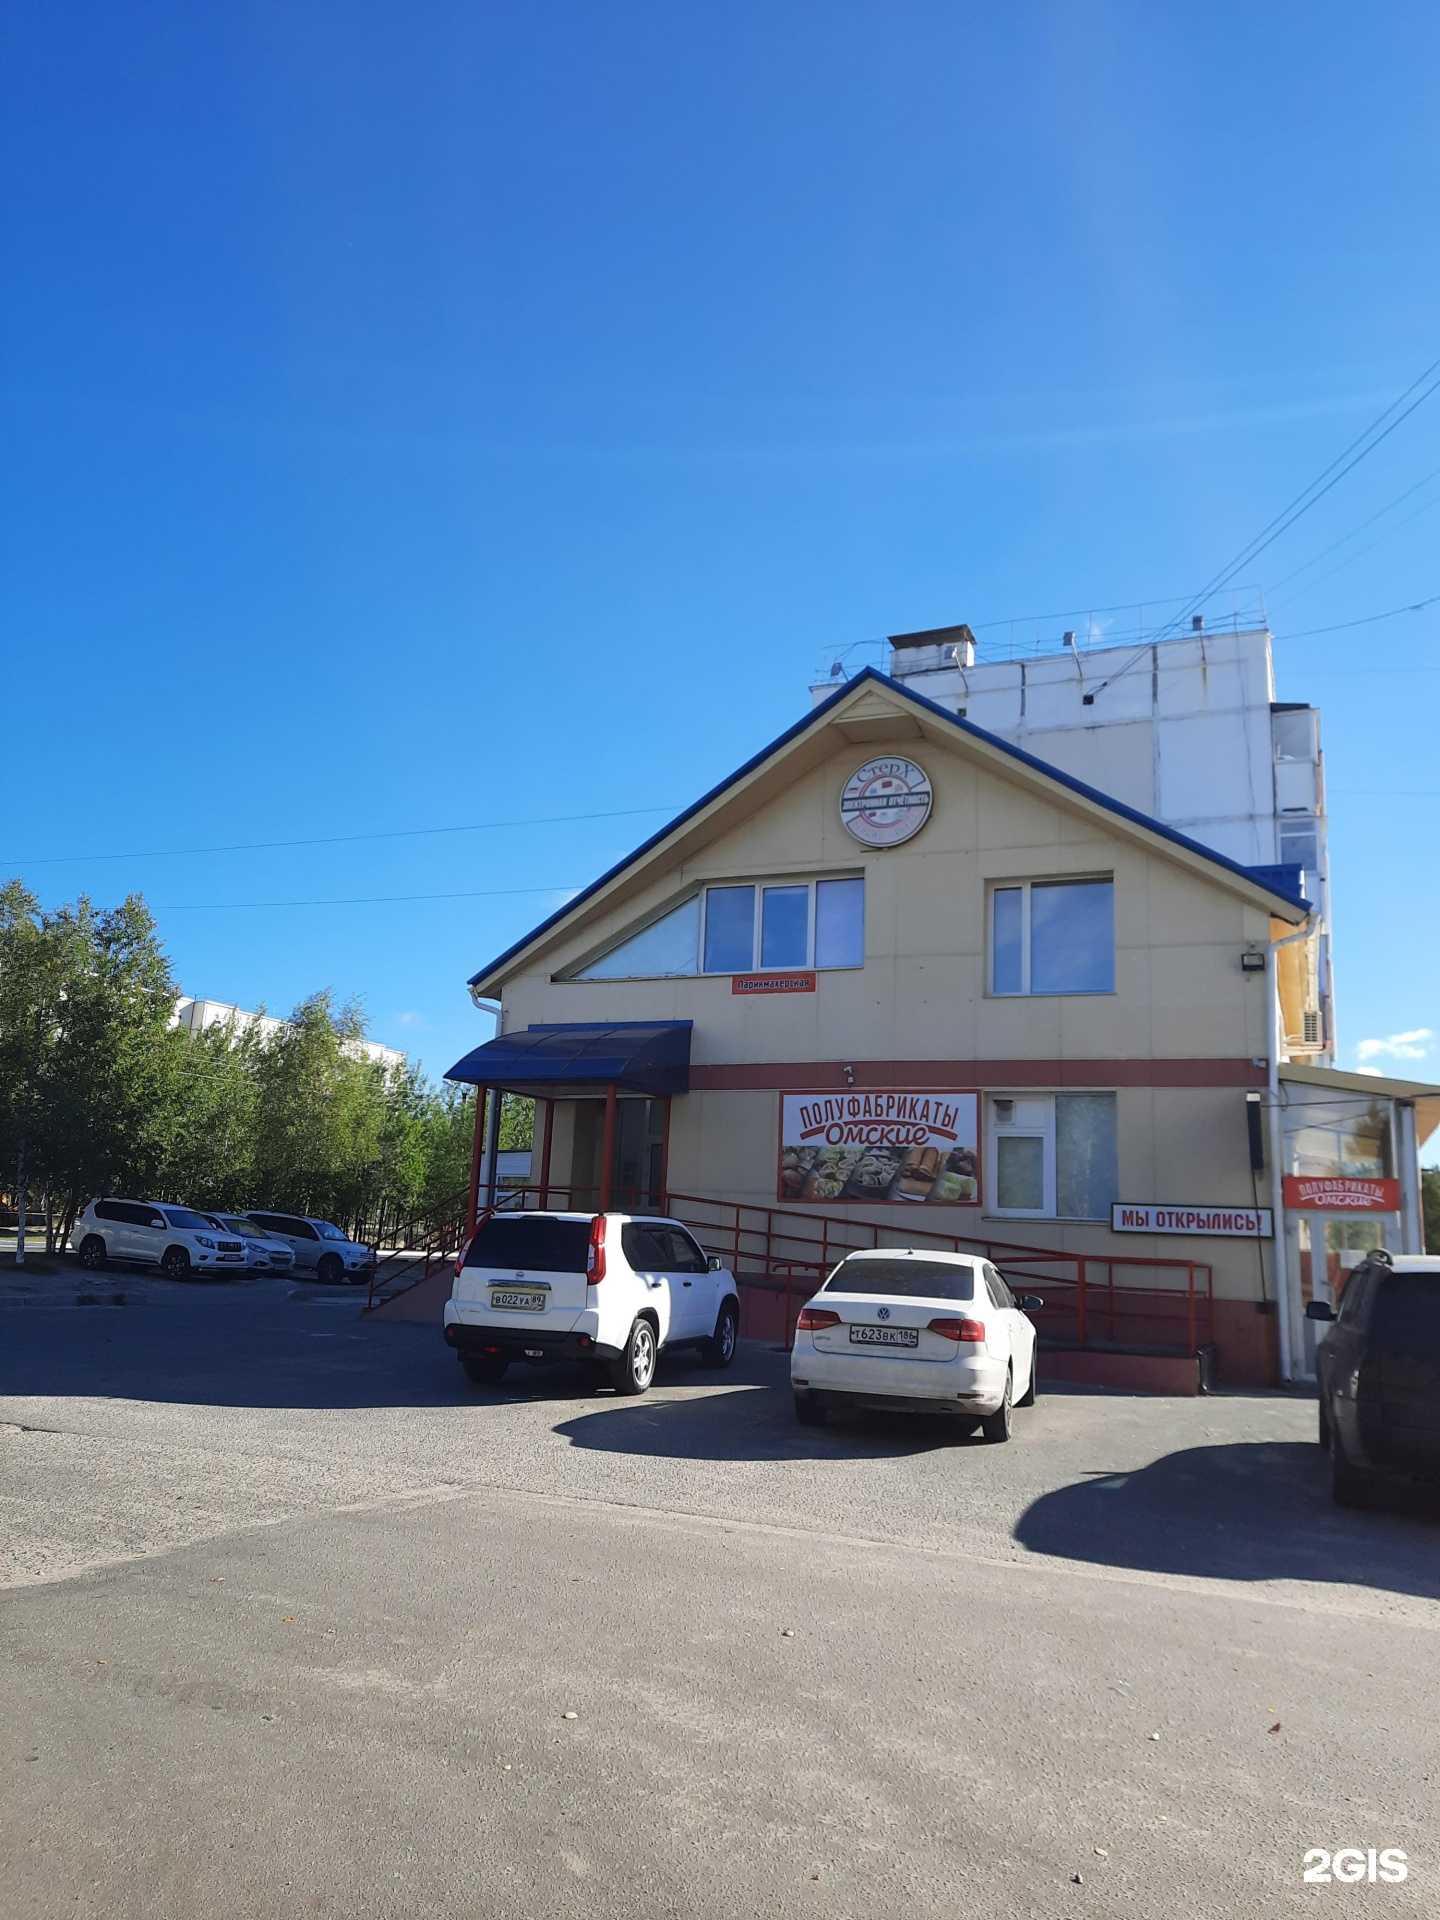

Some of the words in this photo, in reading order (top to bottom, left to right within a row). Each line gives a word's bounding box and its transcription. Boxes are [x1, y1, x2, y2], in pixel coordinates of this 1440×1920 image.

[800, 1095, 959, 1130] ПОЛУФАБРИКАТЫ
[825, 1123, 930, 1146] Омские
[1299, 1179, 1385, 1198] ПОЛУФАБРИКАТЫ
[1122, 1210, 1149, 1227] МЫ
[1156, 1211, 1263, 1232] ОТКРЫЛИСЬ!
